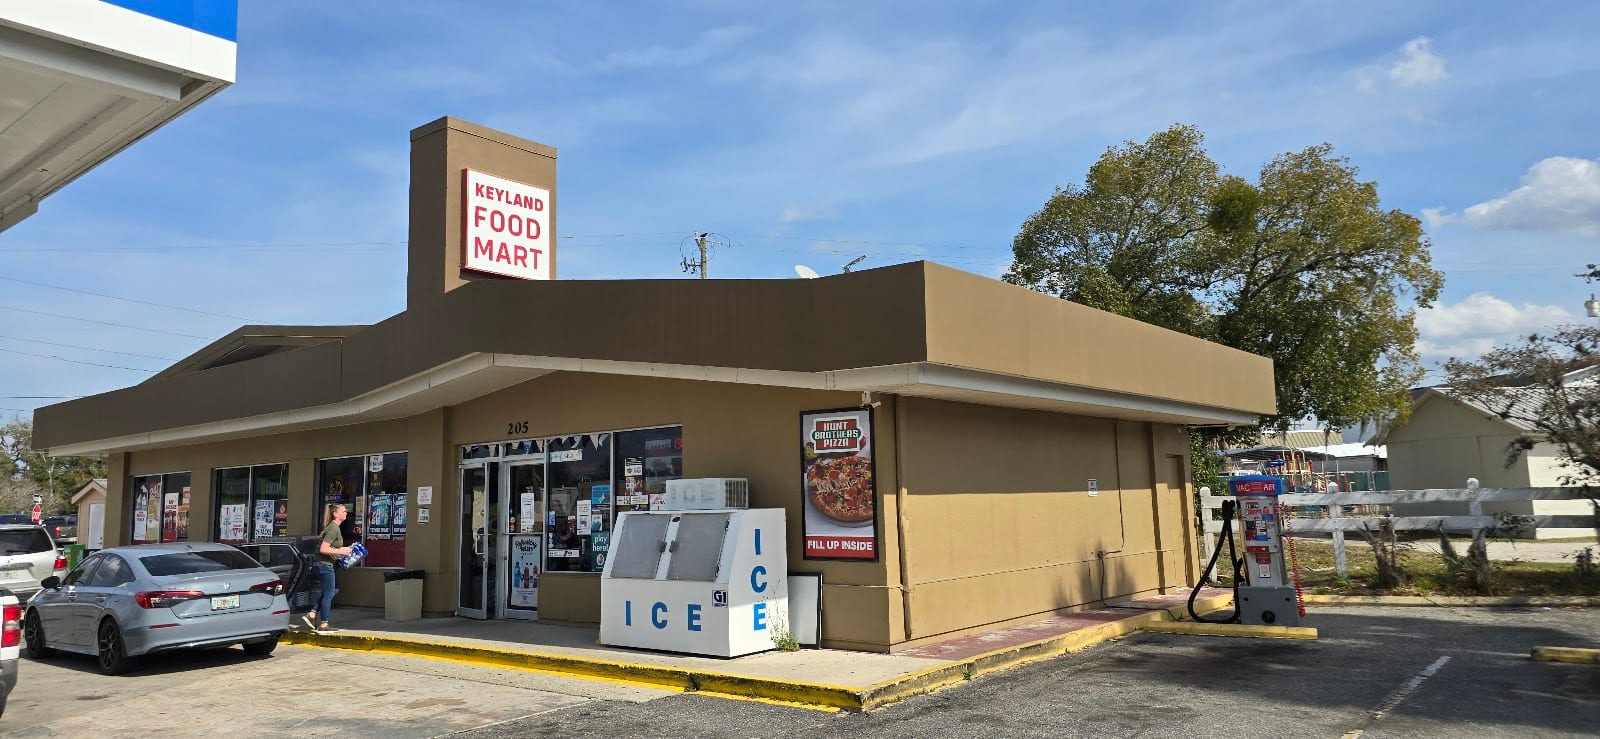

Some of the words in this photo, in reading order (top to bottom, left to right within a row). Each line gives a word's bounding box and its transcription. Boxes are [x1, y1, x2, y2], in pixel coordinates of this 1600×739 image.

[475, 182, 544, 212] KEYLAND
[474, 205, 541, 240] FOOD
[474, 236, 543, 270] MART
[507, 421, 529, 435] 205
[823, 421, 849, 431] HUNT
[814, 429, 859, 440] BROTHERS
[823, 437, 849, 448] PIZZA
[1235, 484, 1250, 492] VAC
[1263, 483, 1276, 491] AIR
[594, 535, 608, 544] play
[592, 543, 609, 552] here!
[807, 540, 825, 549] FILL
[826, 541, 840, 550] UP
[841, 541, 873, 551] INSIDE
[750, 528, 768, 632] ICE
[625, 600, 702, 632] ICE
